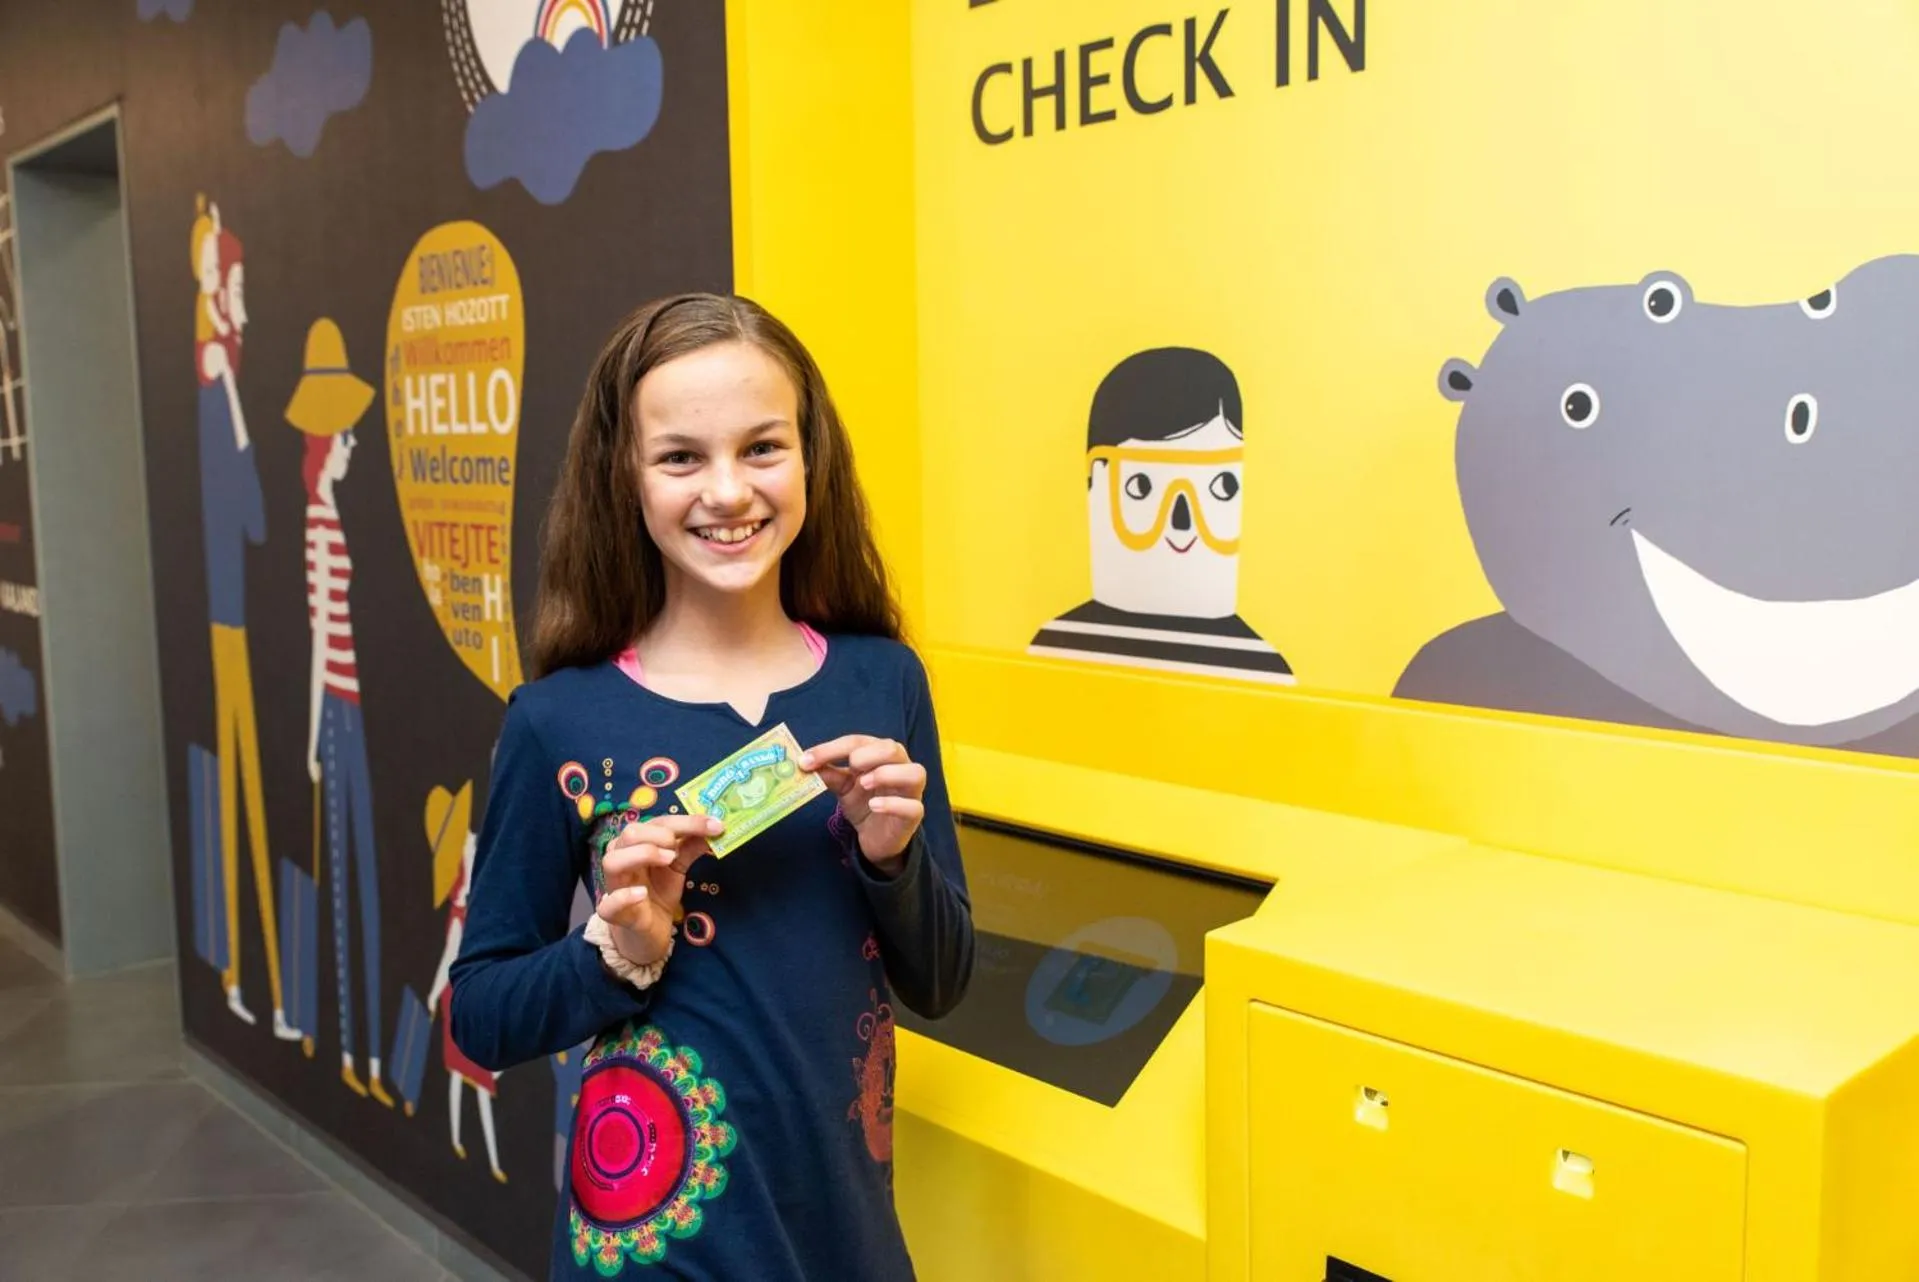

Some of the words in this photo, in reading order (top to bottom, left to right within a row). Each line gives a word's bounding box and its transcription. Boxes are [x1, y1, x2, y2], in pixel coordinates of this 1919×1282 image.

[970, 8, 1236, 146] CHECK
[1275, 0, 1366, 88] IN
[402, 303, 441, 333] ISTEN
[404, 367, 517, 436] HELLO
[409, 447, 512, 486] Welcome
[451, 567, 483, 594] ben
[451, 603, 483, 623] ven
[452, 627, 484, 651] uto
